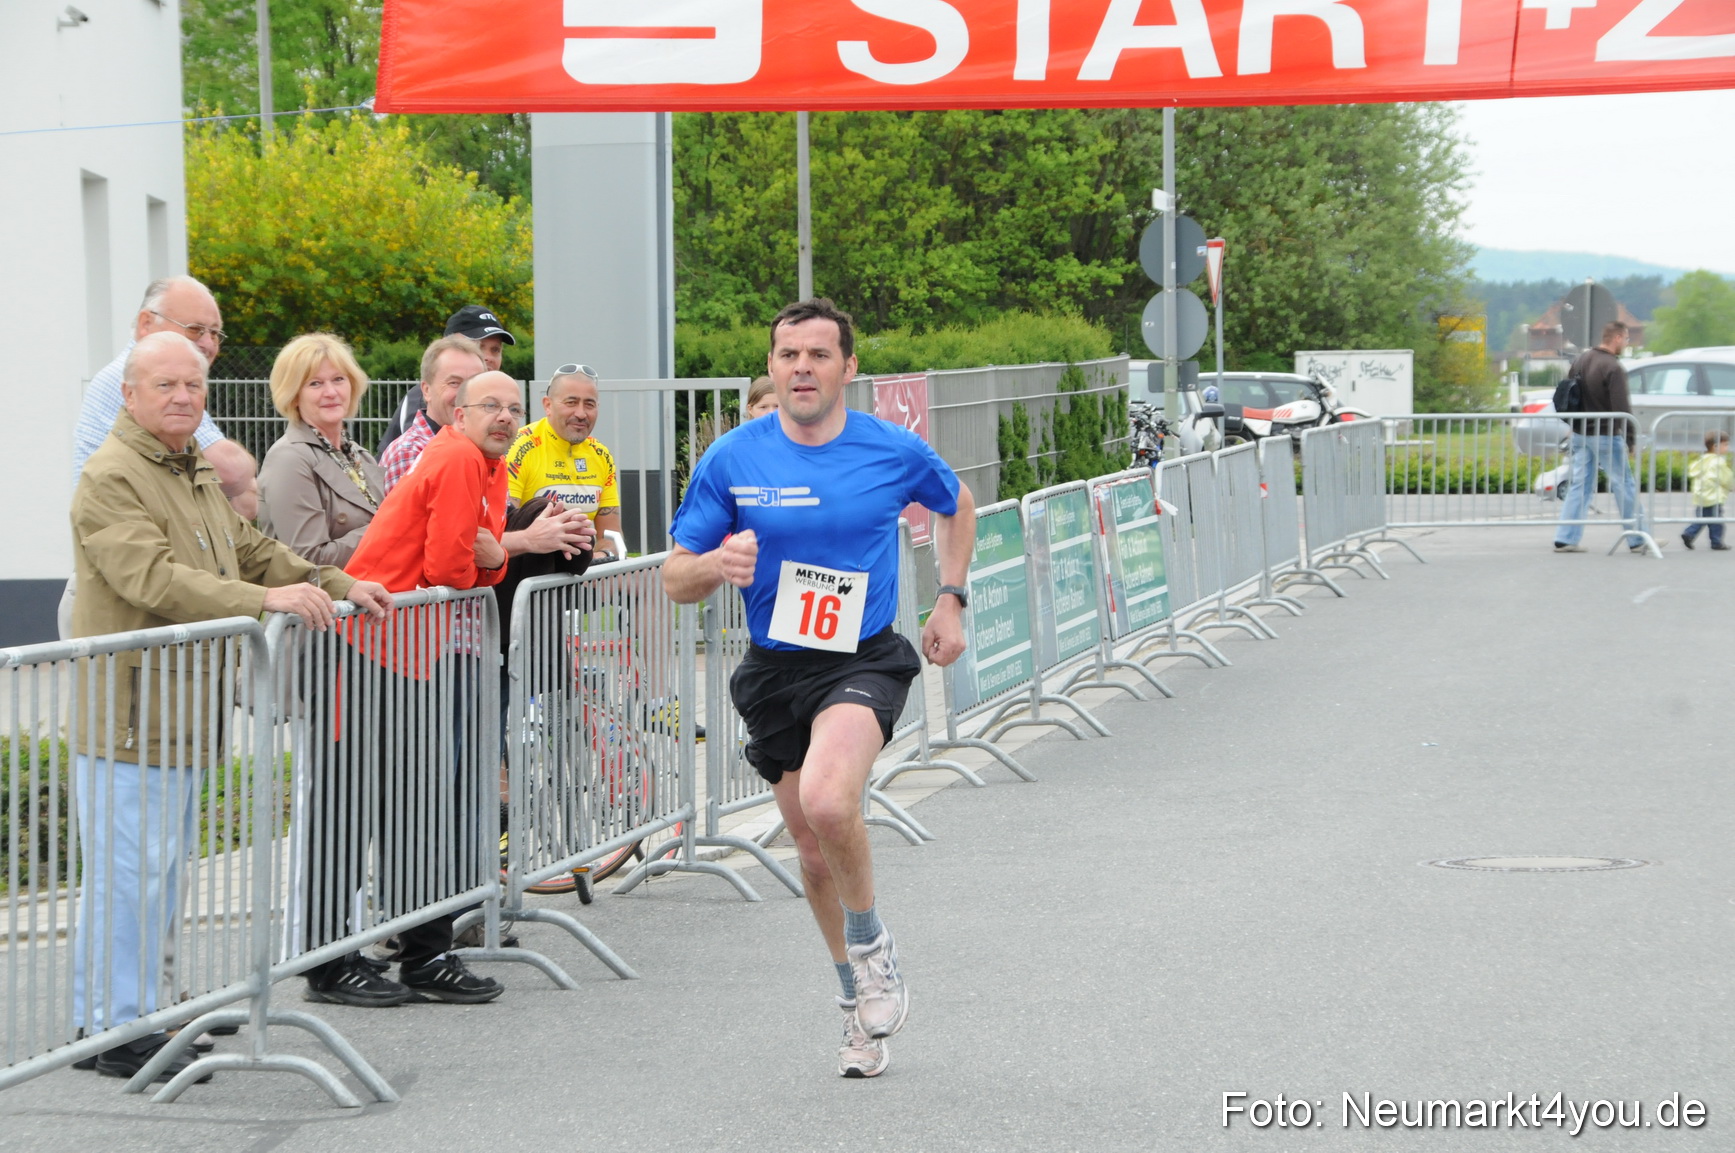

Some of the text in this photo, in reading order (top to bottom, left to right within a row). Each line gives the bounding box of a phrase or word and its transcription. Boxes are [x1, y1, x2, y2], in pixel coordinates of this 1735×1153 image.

[795, 568, 836, 585] MEYER
[795, 577, 836, 592] WERBUNG
[798, 590, 842, 640] 16
